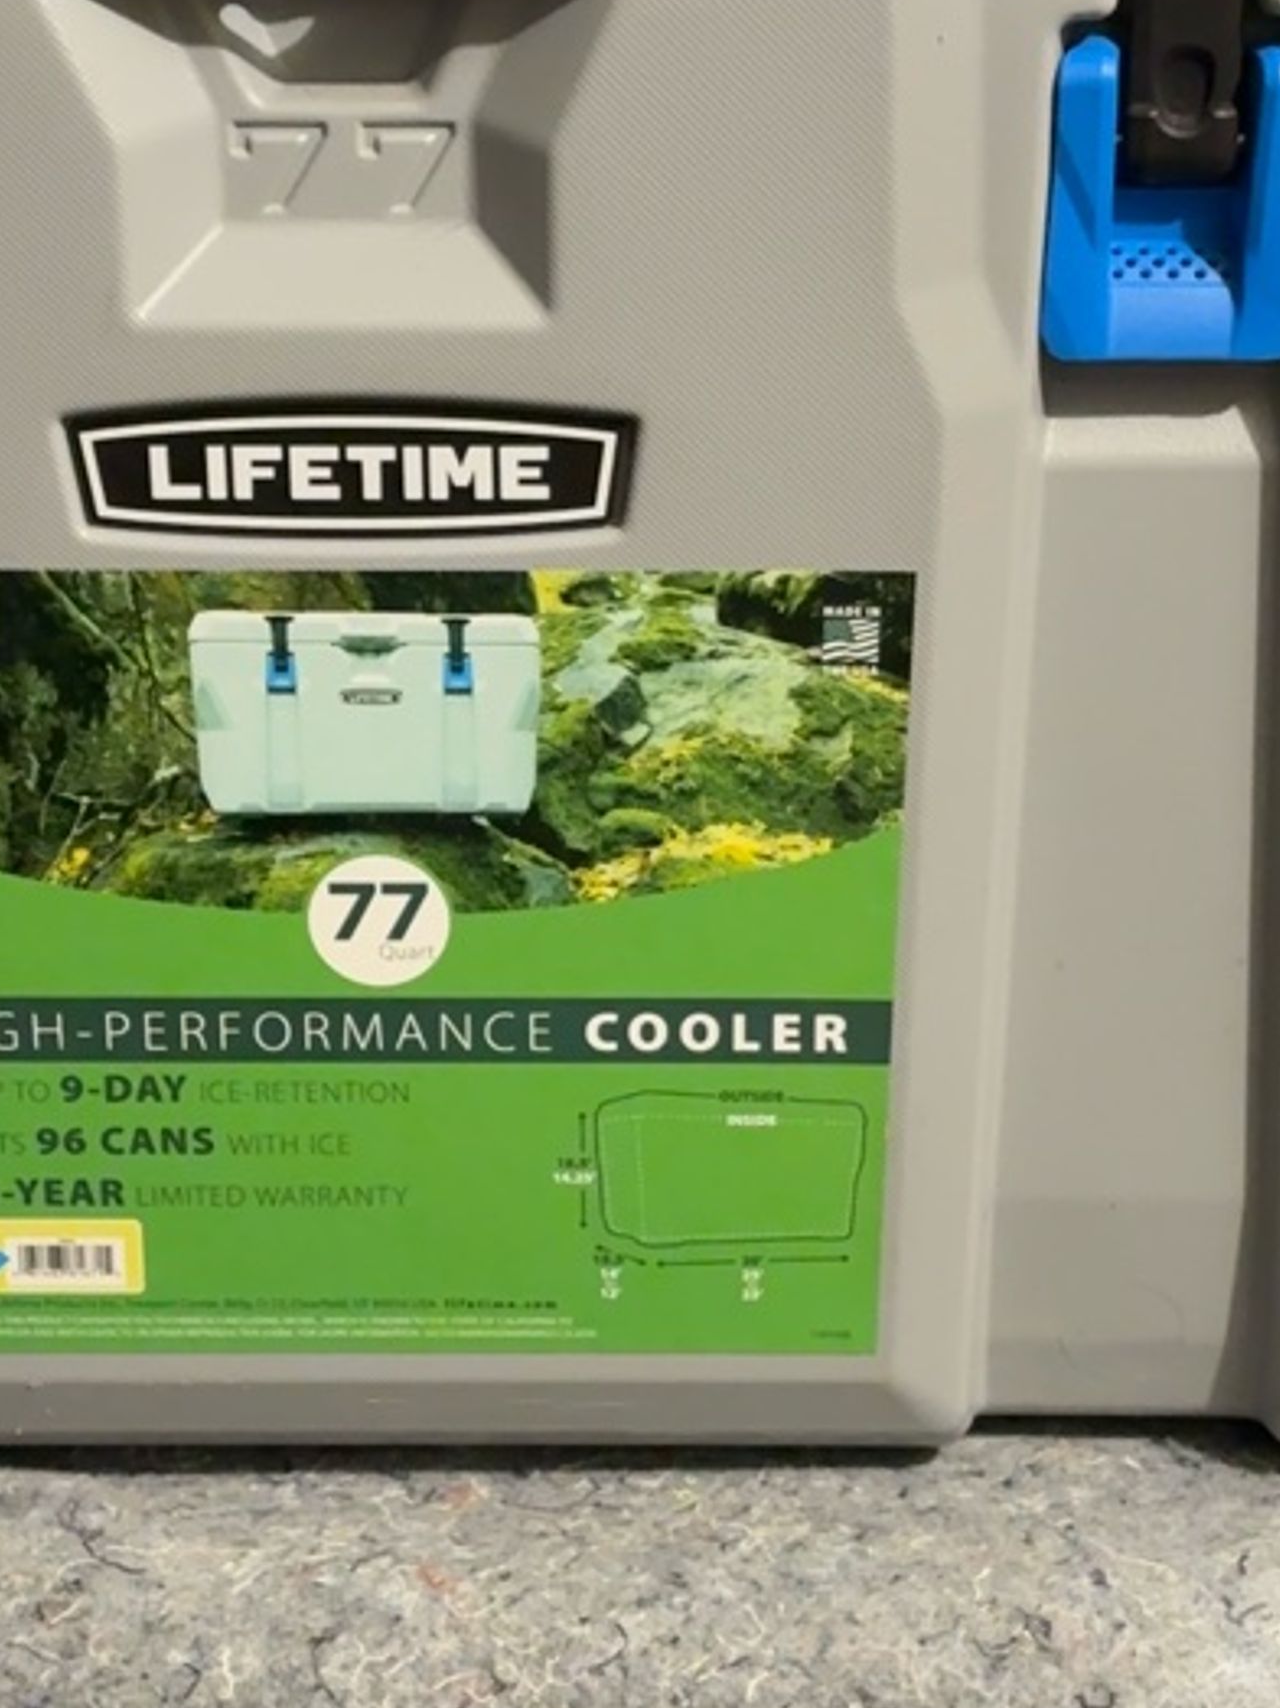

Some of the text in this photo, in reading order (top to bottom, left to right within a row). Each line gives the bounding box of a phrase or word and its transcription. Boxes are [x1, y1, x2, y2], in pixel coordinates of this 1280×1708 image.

[228, 120, 457, 215] 77
[146, 444, 551, 502] LIFETIME
[327, 882, 429, 941] 77
[378, 944, 435, 962] Quart
[583, 1012, 849, 1054] COOLER
[15, 1079, 55, 1104] TO
[58, 1074, 189, 1104] 9-DAY
[198, 1080, 411, 1104] ICE-RETENTION
[35, 1127, 88, 1156] 96
[100, 1127, 216, 1156] CANS
[227, 1134, 302, 1156] WITH
[308, 1134, 352, 1156] ICE
[135, 1186, 246, 1208] LIMITED
[249, 1185, 410, 1208] WARRANTY
